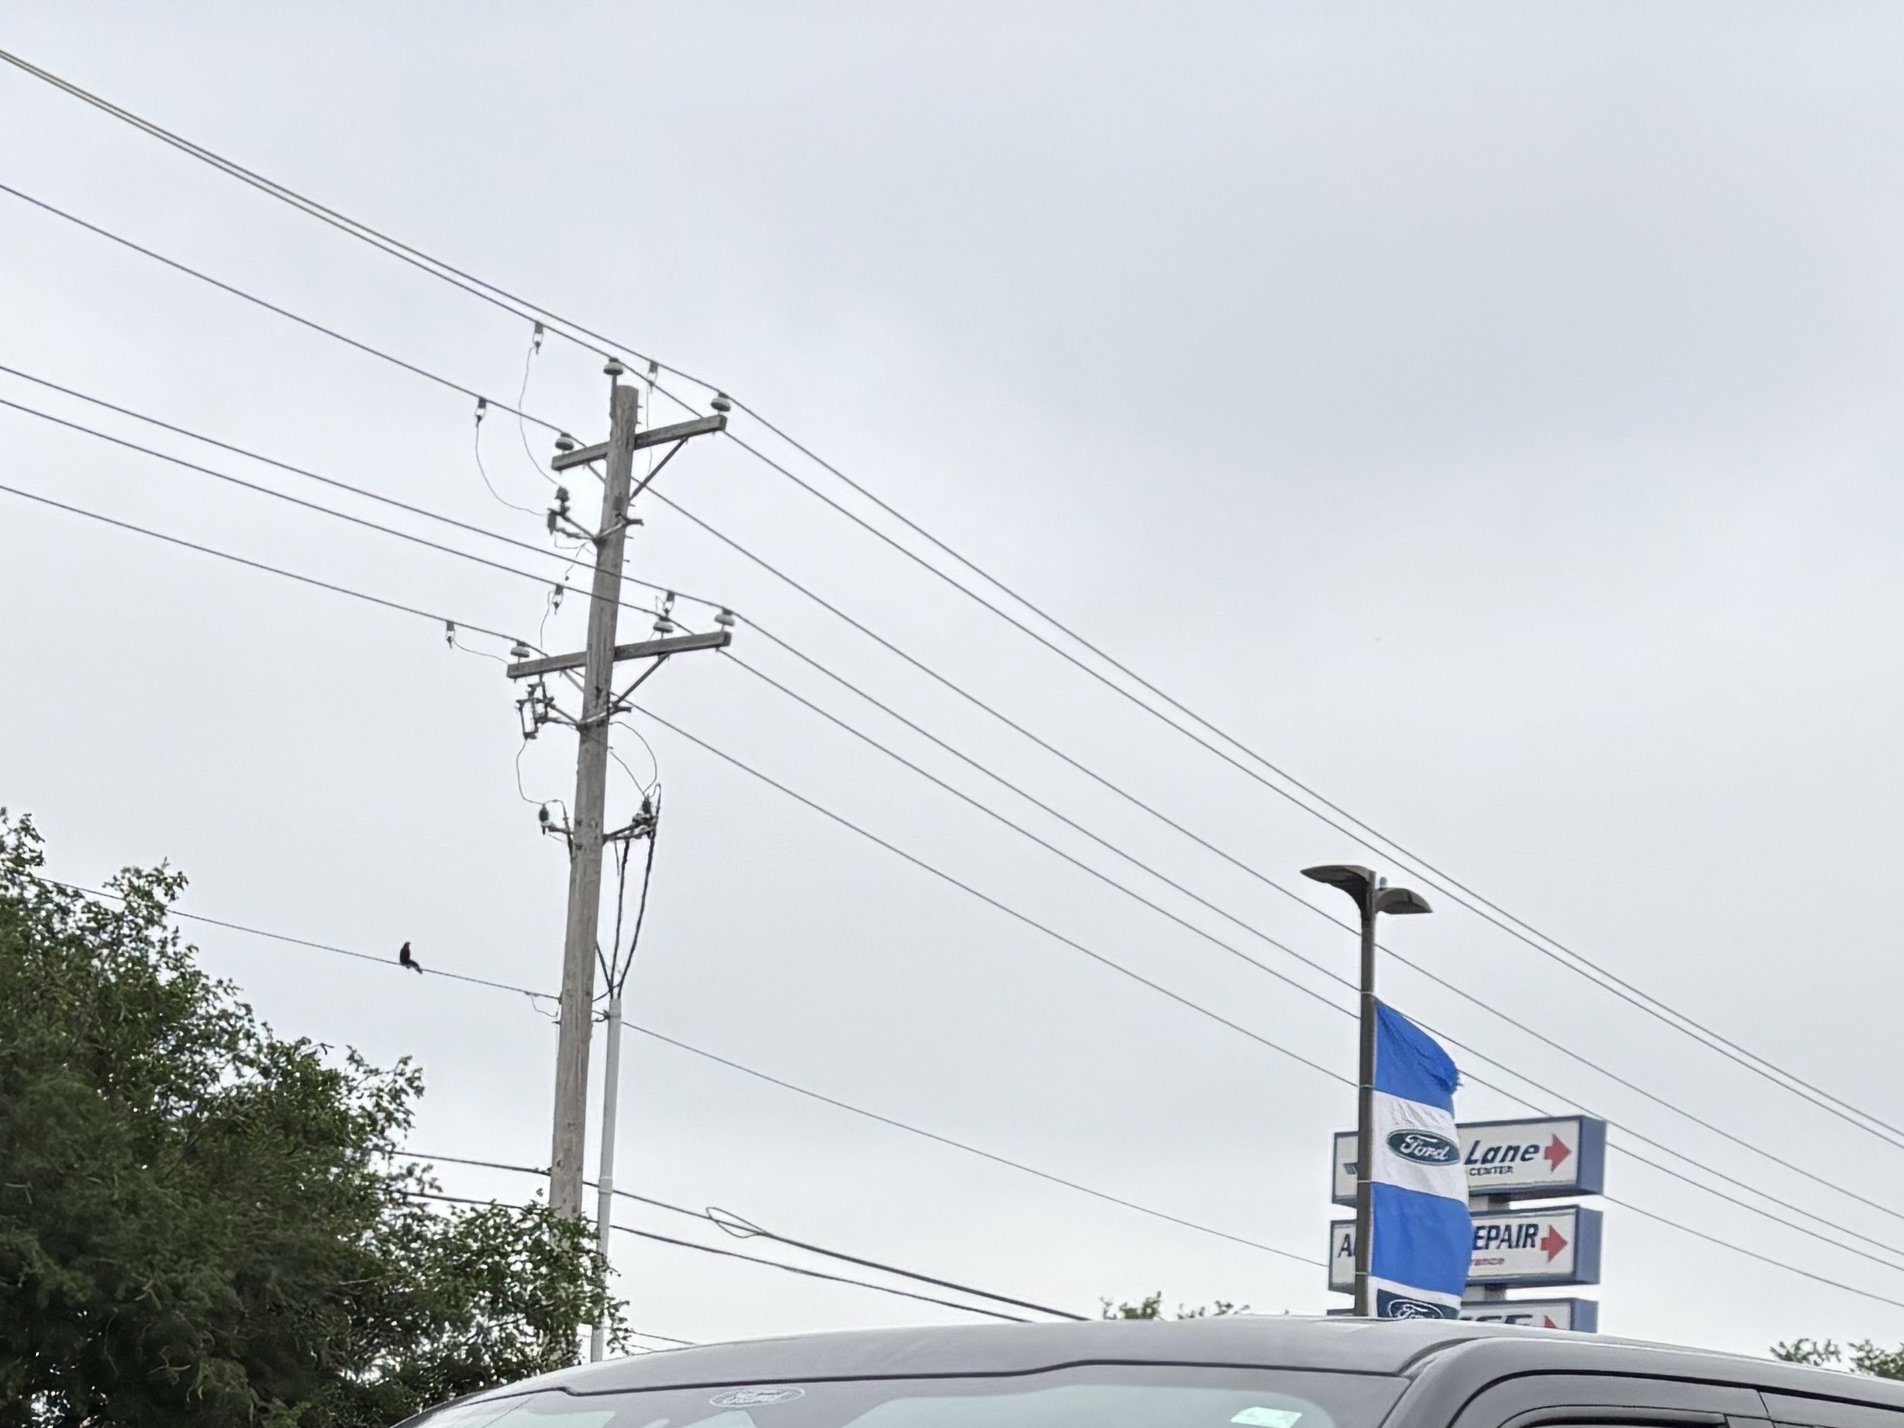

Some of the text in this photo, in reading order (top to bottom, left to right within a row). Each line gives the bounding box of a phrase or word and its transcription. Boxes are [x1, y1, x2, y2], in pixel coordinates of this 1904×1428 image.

[1400, 1134, 1450, 1161] Ford
[1464, 1140, 1540, 1166] Lane
[1472, 1223, 1540, 1251] EPAIR
